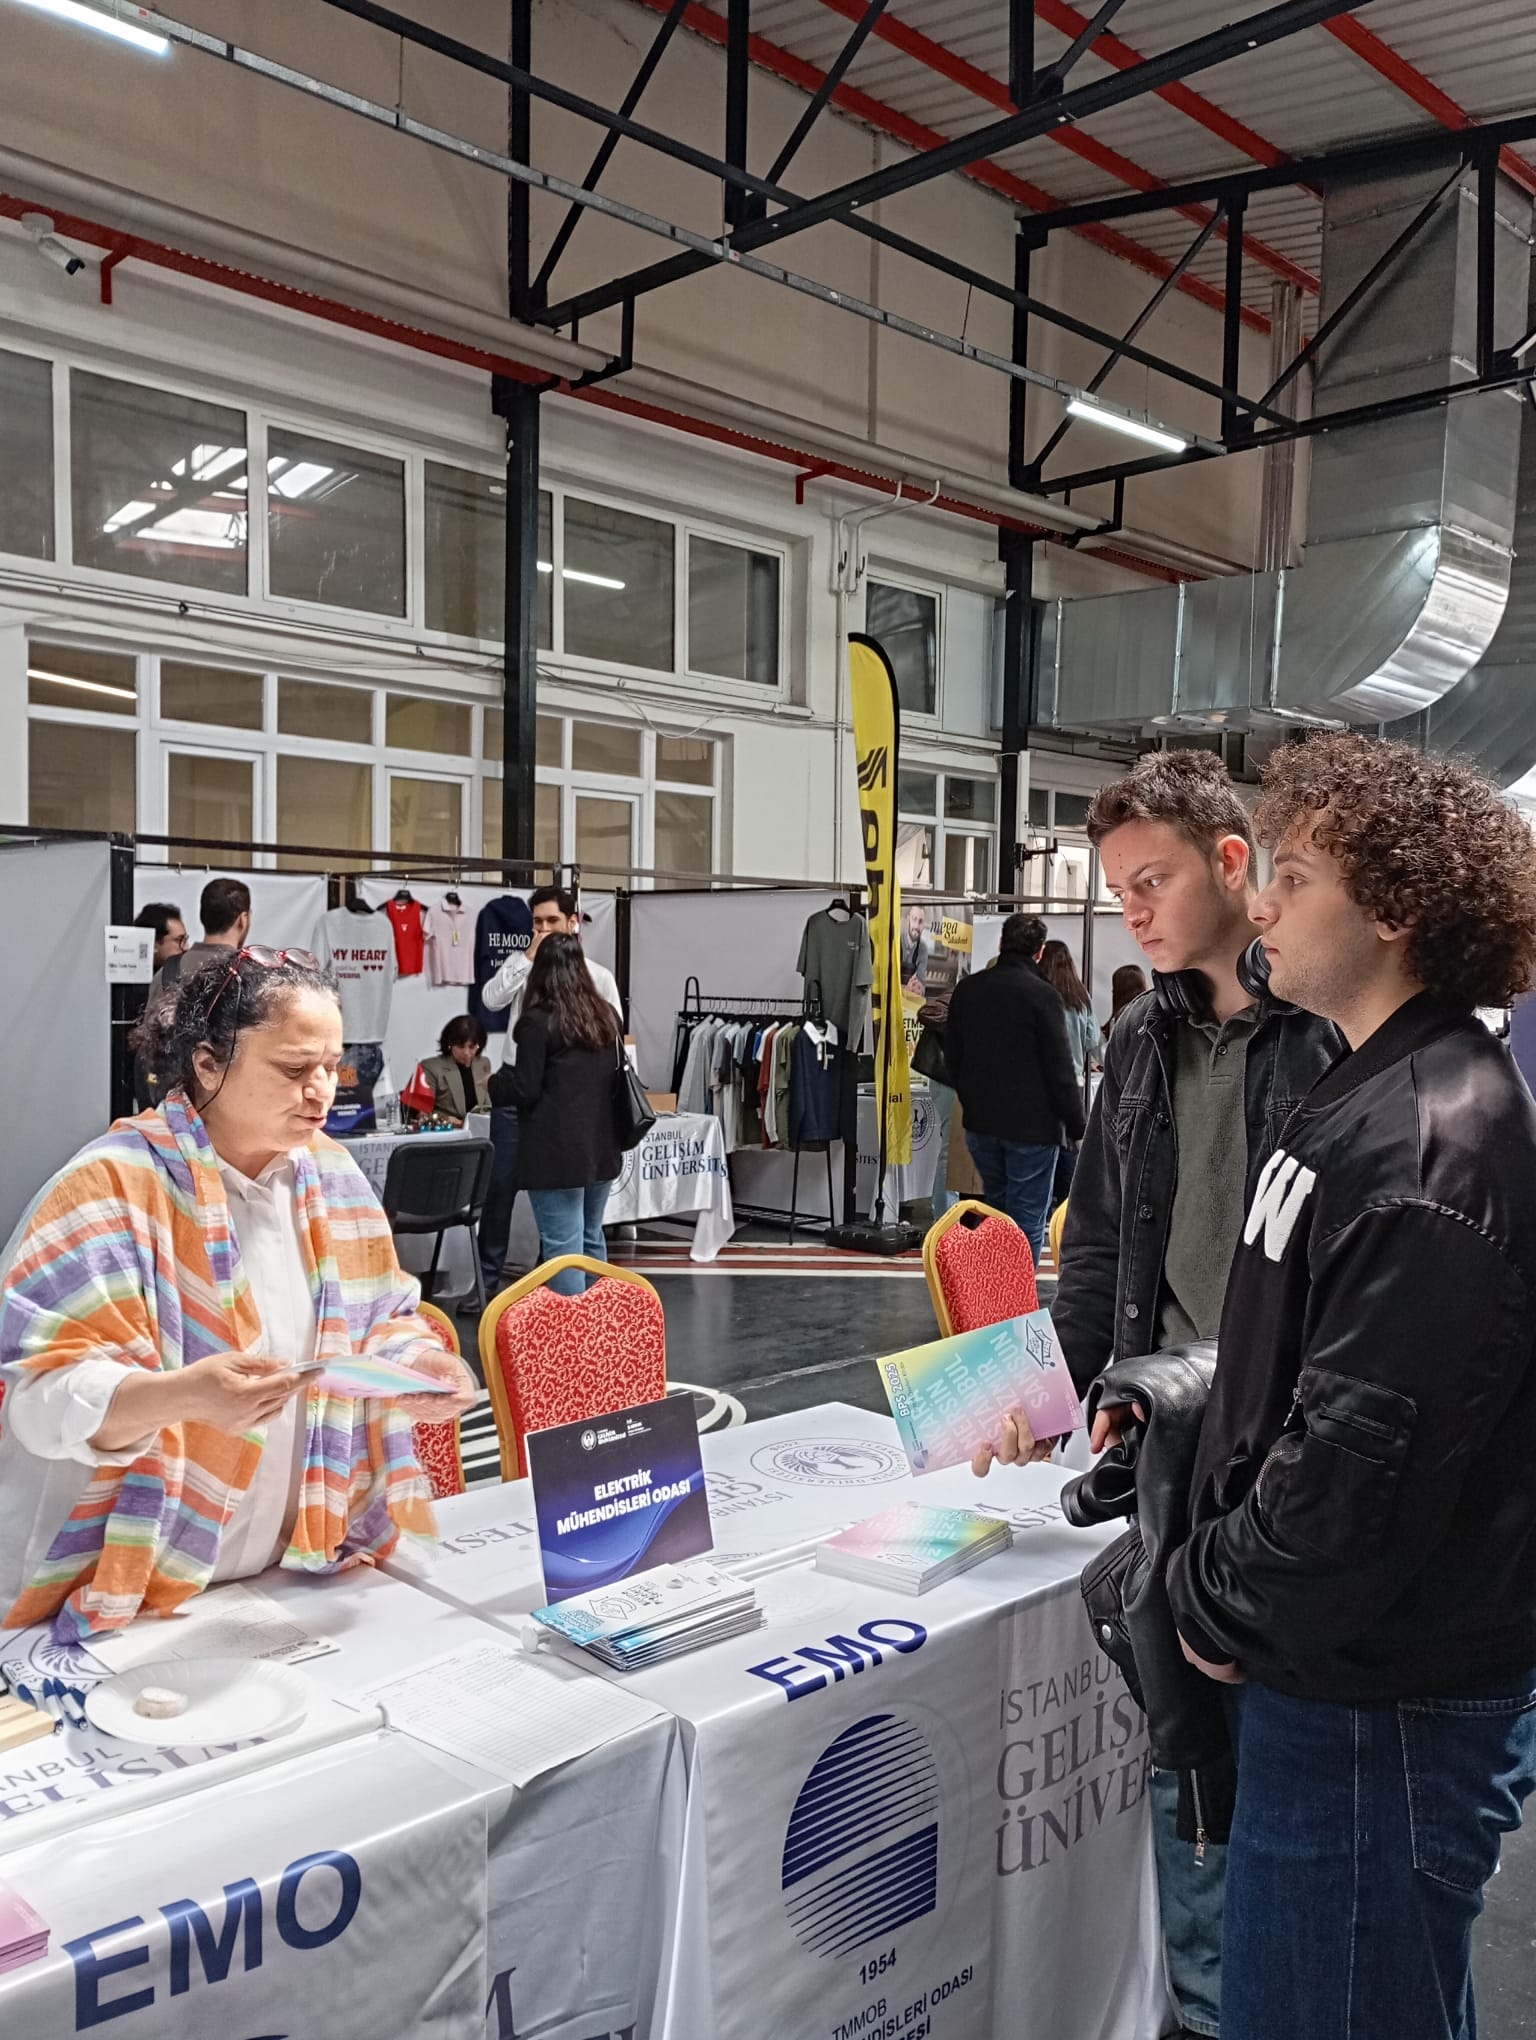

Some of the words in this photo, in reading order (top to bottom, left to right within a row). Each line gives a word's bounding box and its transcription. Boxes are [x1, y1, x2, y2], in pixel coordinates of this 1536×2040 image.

[502, 933, 531, 948] MOOD
[930, 920, 958, 940] mega
[351, 949, 388, 961] HEART
[642, 1139, 704, 1162] GELİŞİM
[643, 1131, 682, 1143] STANBUL
[884, 1363, 903, 1394] 2025
[989, 1330, 1050, 1410] SAMSUN
[895, 1393, 910, 1417] BPS
[594, 1469, 653, 1501] ELEKTRİK
[556, 1488, 651, 1536] MÜHENDİSLERİ
[652, 1479, 691, 1504] ODASI
[744, 1619, 928, 1703] EMO
[2, 1747, 123, 1790] NBUL
[60, 1849, 362, 2033] EMO
[858, 1947, 897, 1986] 1954
[930, 1964, 974, 2007] ODASI
